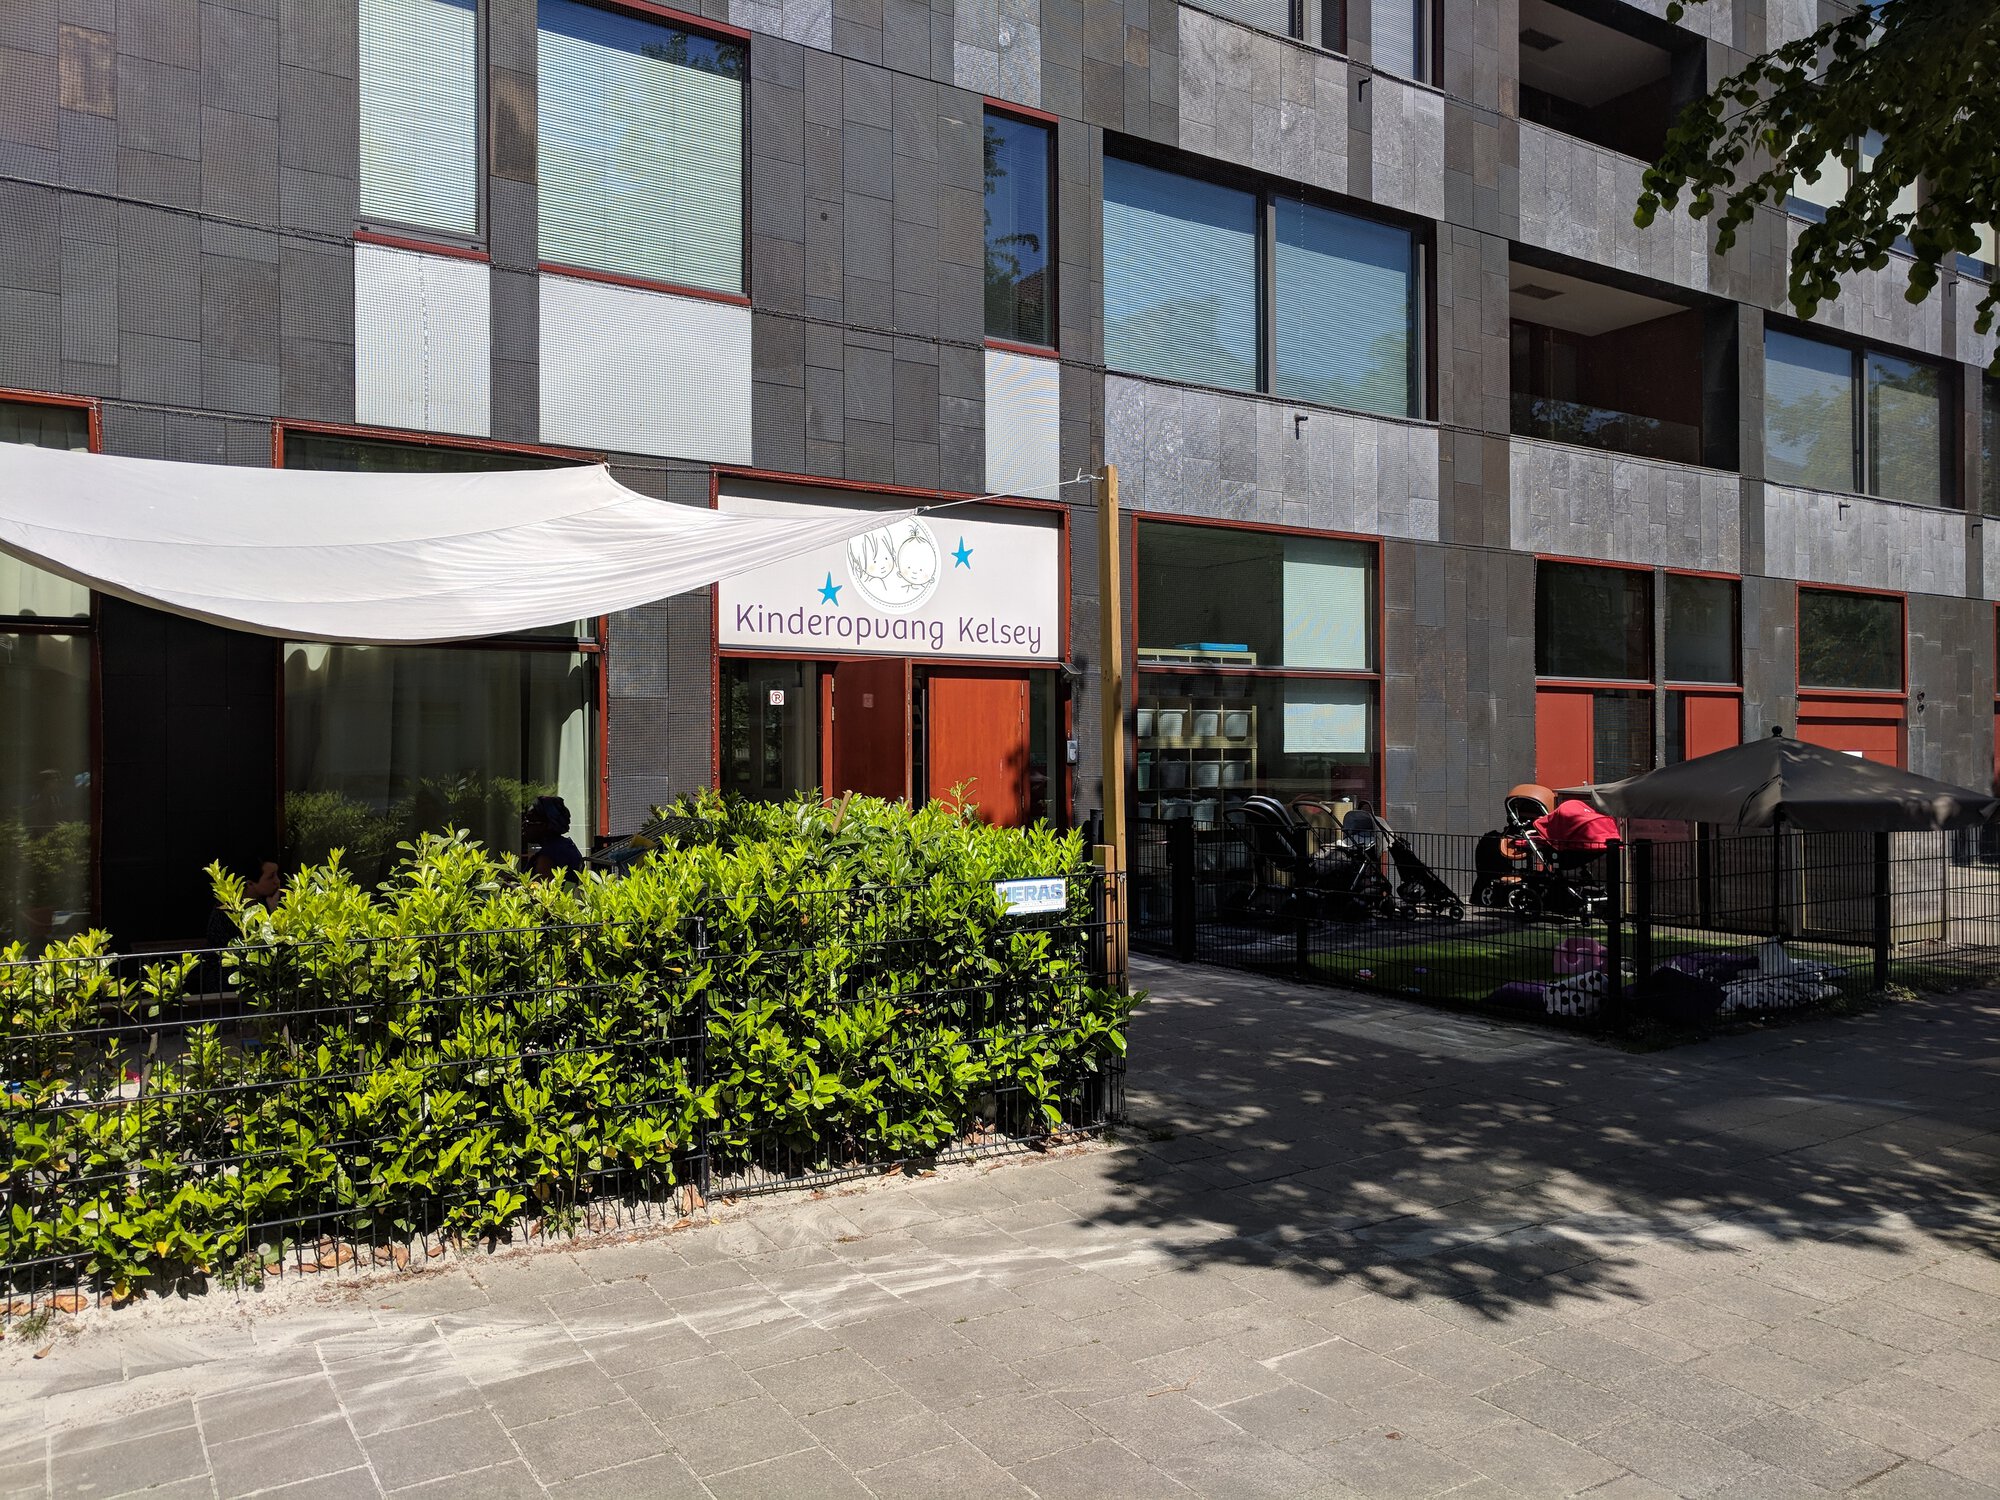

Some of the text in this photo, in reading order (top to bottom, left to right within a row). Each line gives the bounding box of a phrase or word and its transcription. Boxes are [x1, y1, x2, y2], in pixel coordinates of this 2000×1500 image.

[736, 604, 1041, 653] Kinderopvang Kelsey
[998, 884, 1063, 902] HERAS
